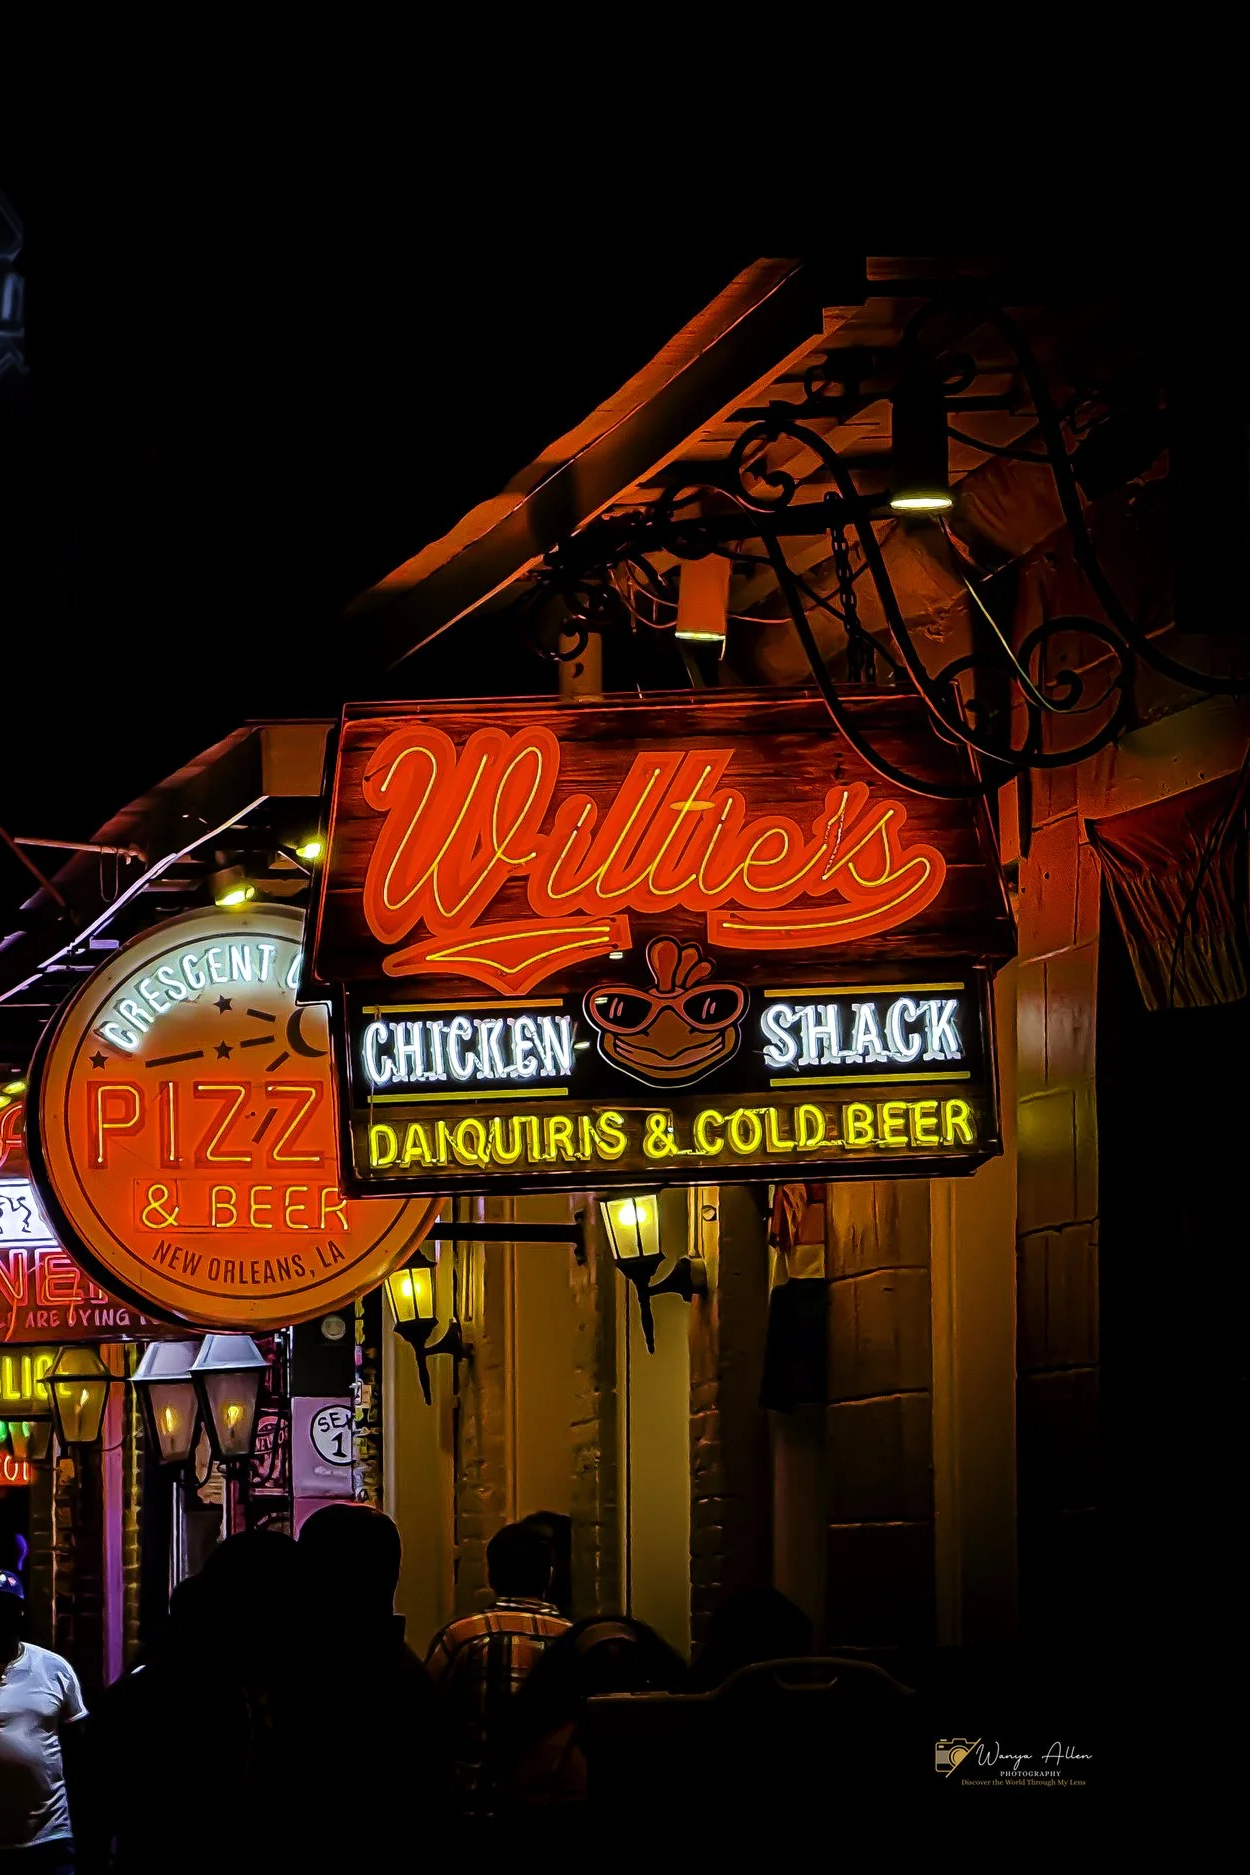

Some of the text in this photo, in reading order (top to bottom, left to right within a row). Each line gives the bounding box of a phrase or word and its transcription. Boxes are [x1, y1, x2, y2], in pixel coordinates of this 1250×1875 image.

[99, 944, 276, 1055] CRESCENT
[362, 998, 964, 1087] CHICKEN SHACK
[85, 1080, 326, 1168] PIZZ
[369, 1099, 974, 1170] DAIQUIRIS & COLD BEER
[142, 1184, 349, 1232] & BEER
[151, 1239, 345, 1285] NEW ORLEANS, LA
[25, 1310, 61, 1328] ARE
